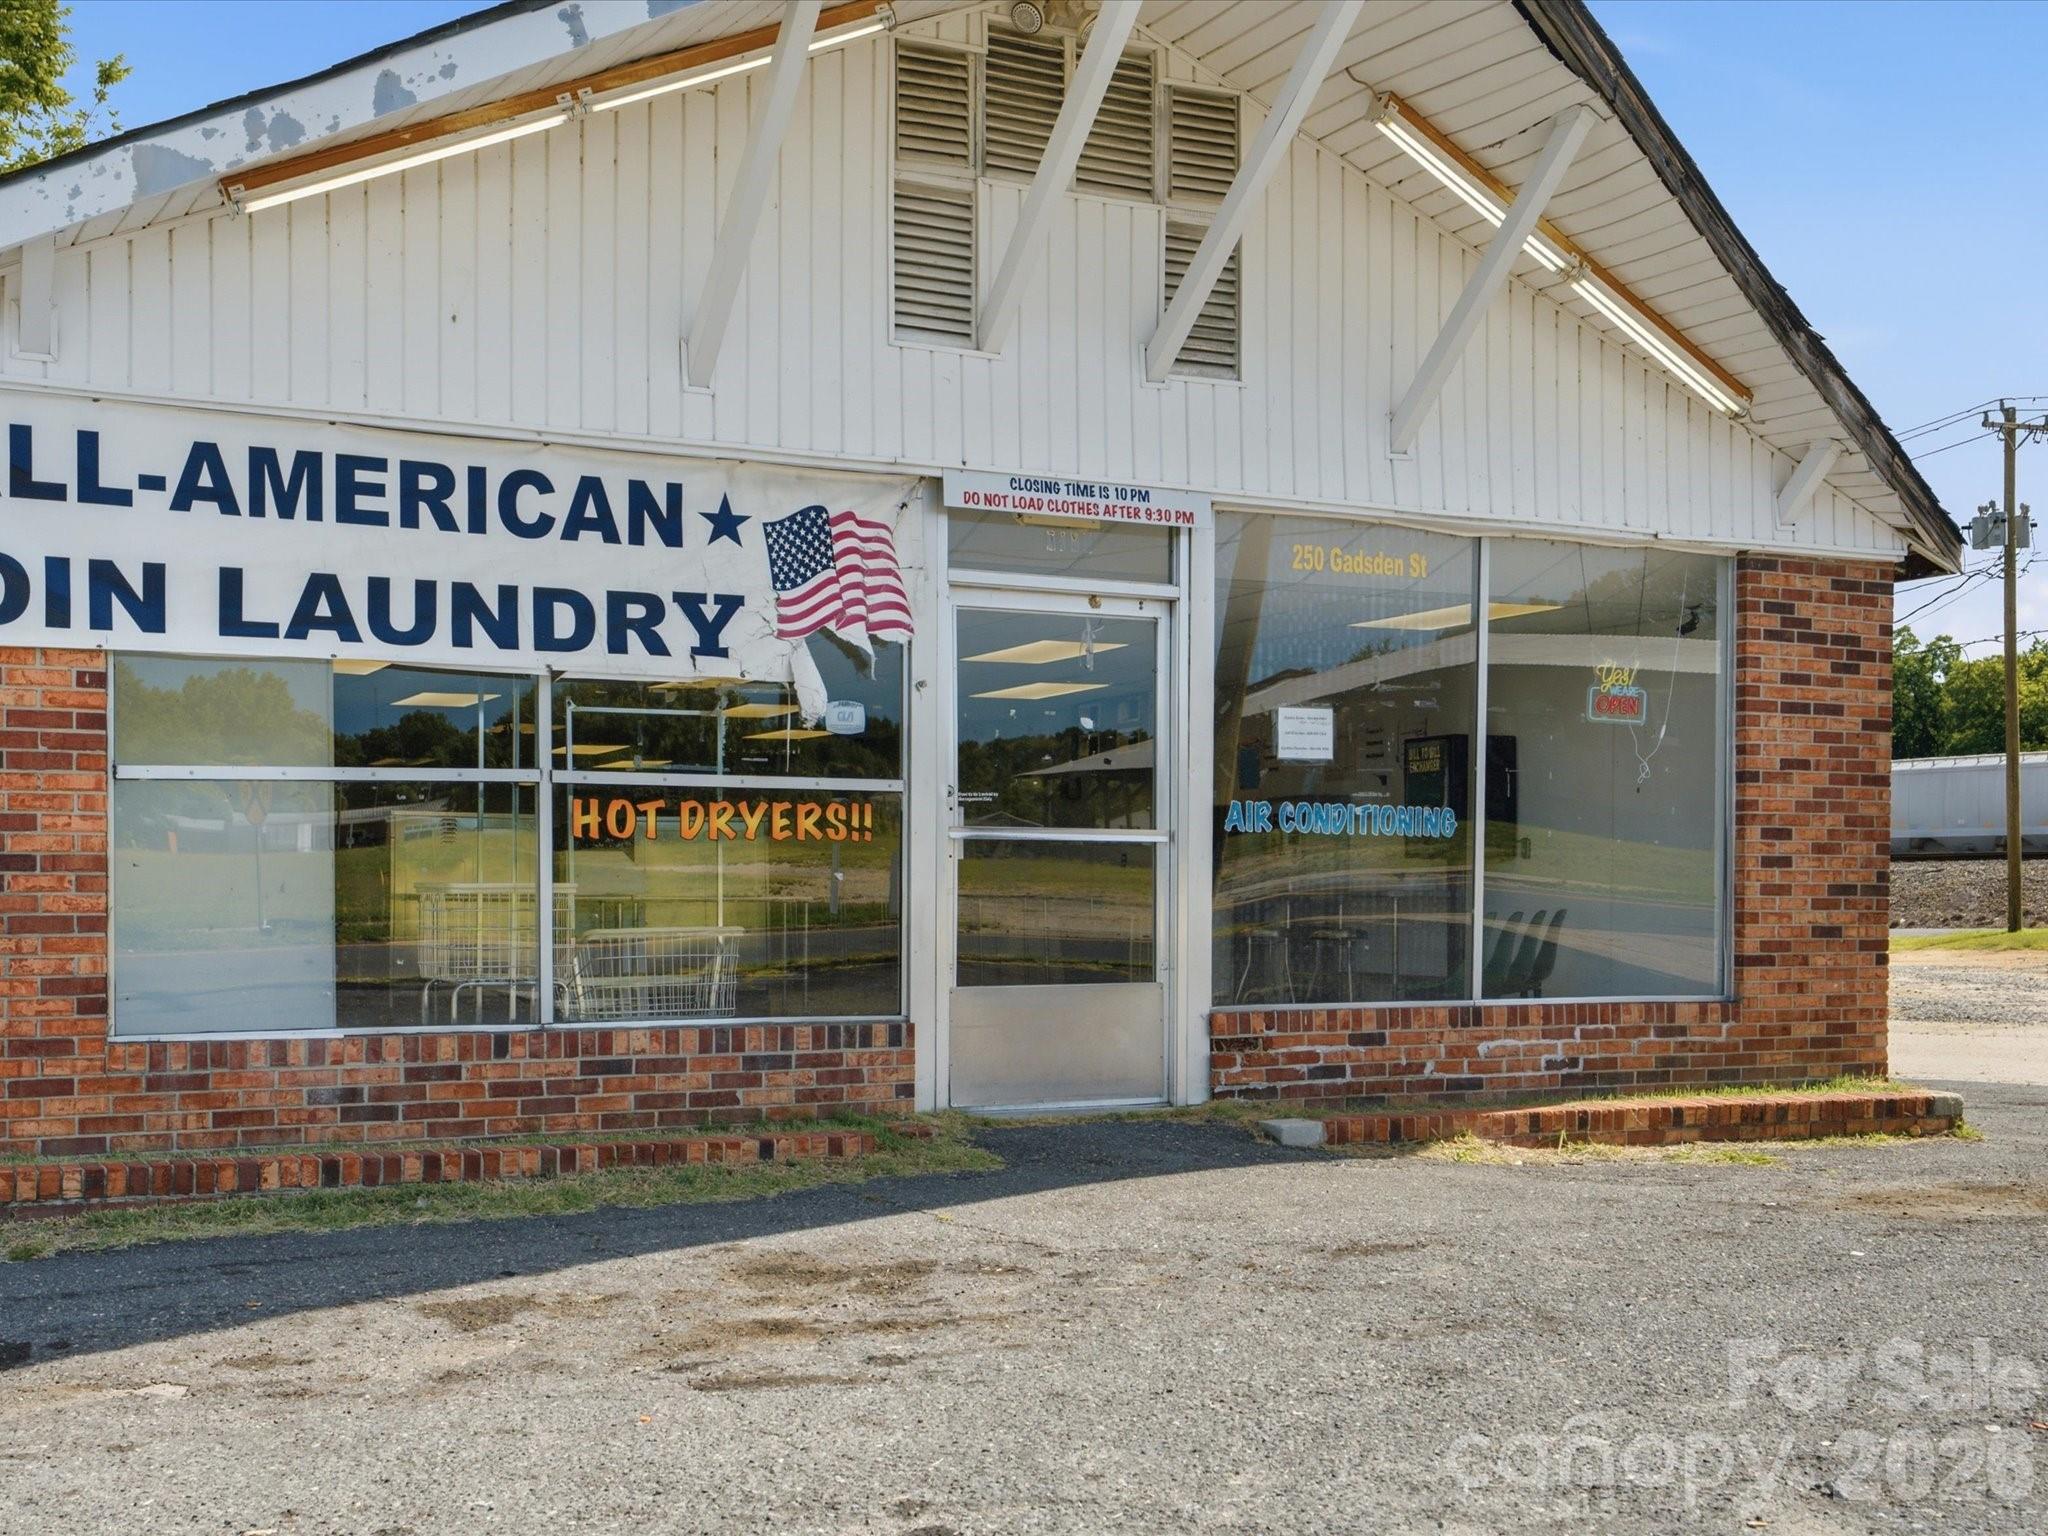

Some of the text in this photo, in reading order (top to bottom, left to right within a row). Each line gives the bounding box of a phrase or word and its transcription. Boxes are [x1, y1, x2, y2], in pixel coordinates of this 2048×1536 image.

[0, 423, 684, 548] LL-AMERICAN
[1010, 477, 1150, 503] CLOSING TIME IS 10 PM
[963, 491, 1195, 525] DO NOT LOAD CLOTHES AFTER 9:30 PM
[1292, 544, 1428, 578] 250 Gadsden St
[219, 566, 745, 659] LAUNDRY
[1594, 695, 1640, 716] OPEN
[572, 798, 873, 842] HOT DRYERS!!
[1224, 800, 1458, 838] AIR CONDITIONING
